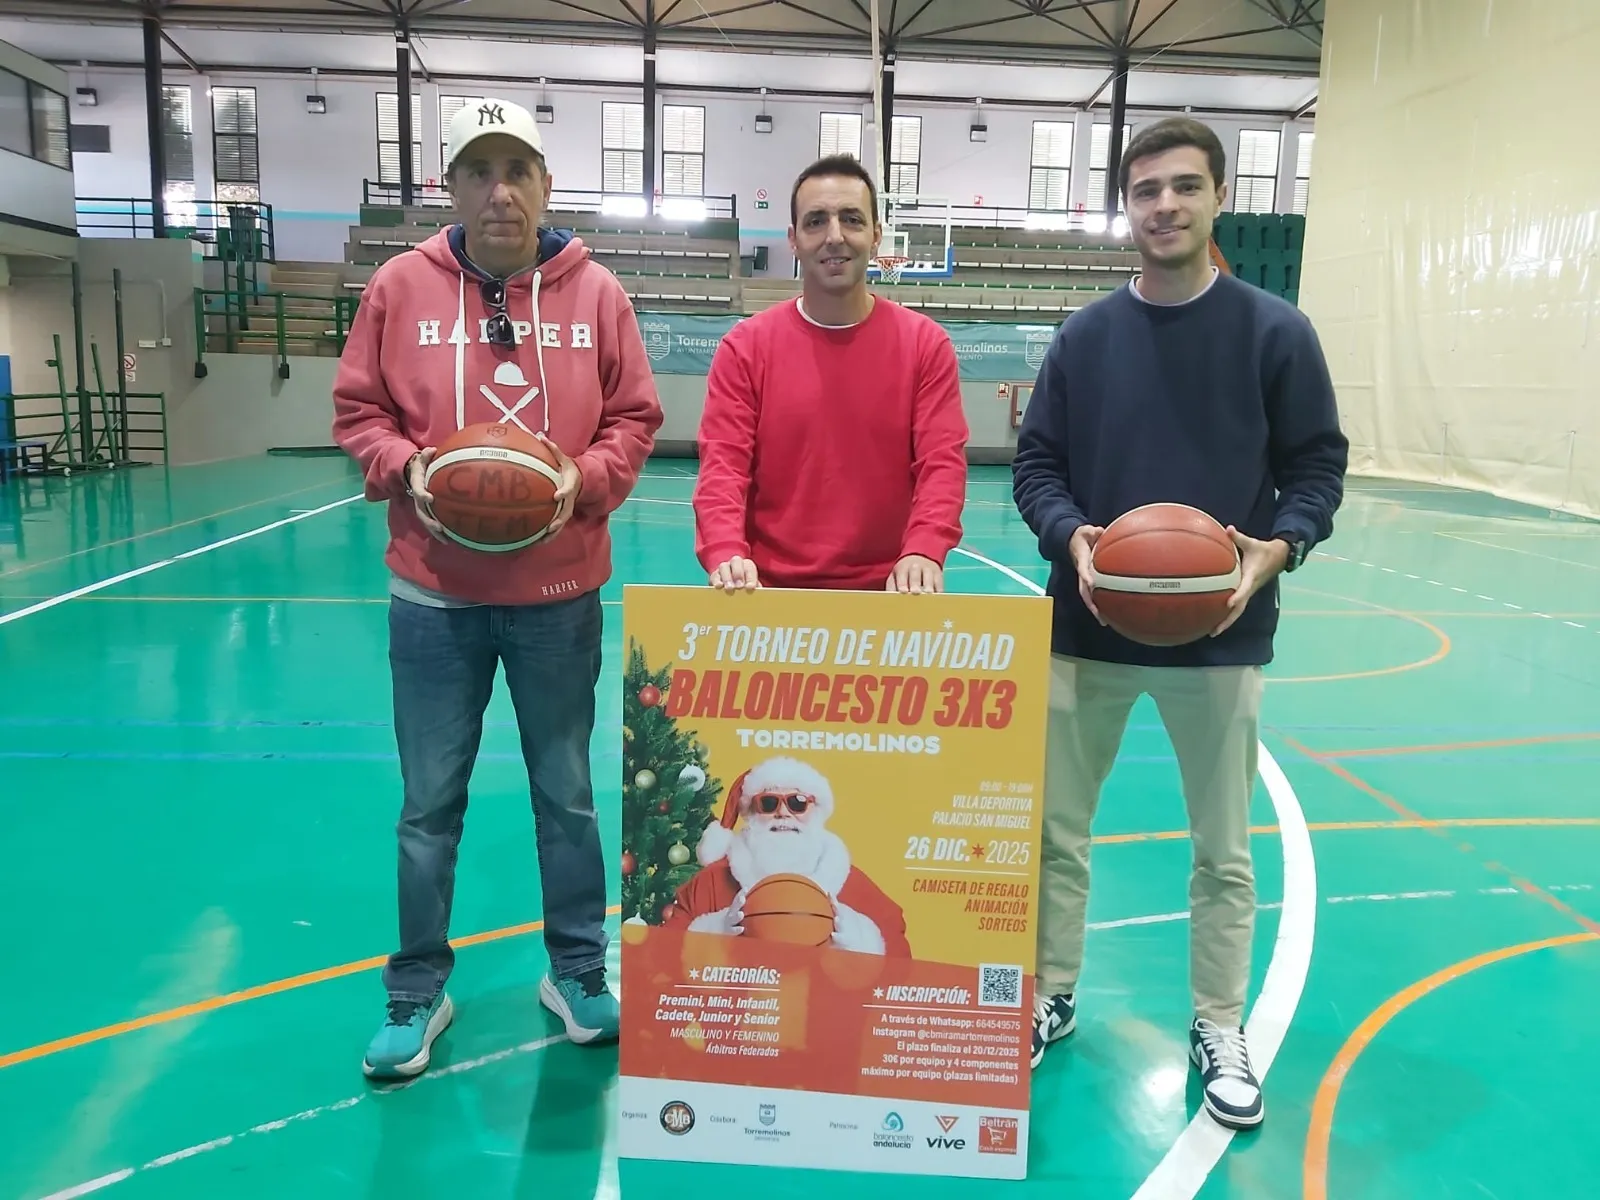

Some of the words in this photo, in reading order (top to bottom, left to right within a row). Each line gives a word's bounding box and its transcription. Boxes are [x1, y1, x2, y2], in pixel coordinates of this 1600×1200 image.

[446, 466, 531, 501] CMB
[541, 580, 579, 596] HARPER
[715, 625, 830, 665] TORNEO
[834, 629, 877, 666] DE
[880, 629, 1015, 671] NAVIDAD
[664, 669, 929, 725] BALONCESTO
[933, 677, 1017, 730] 3X3
[736, 728, 941, 755] TORREMOLINOS
[952, 794, 979, 809] VILLA
[979, 797, 1033, 812] DEPORTIVA
[932, 811, 971, 826] PALACIO
[973, 813, 994, 828] SAN
[994, 815, 1031, 829] MIGUEL
[904, 836, 931, 860] 26
[933, 837, 970, 862] DIC.
[985, 840, 1031, 865] 2025
[912, 879, 967, 895] CAMISETA
[969, 882, 986, 896] DE
[986, 883, 1029, 898] REGALO
[964, 898, 1028, 915] ANIMACIÓN
[978, 917, 1028, 932] SORTEOS
[702, 966, 781, 985] CATEGORÍAS:
[659, 994, 705, 1008] Premini,
[707, 996, 734, 1009] Mini,
[736, 997, 780, 1011] Infantil,
[886, 985, 971, 1005] INSCRIPCIÓN:
[655, 1009, 696, 1022] Cadete,
[698, 1011, 733, 1023] Junior
[733, 1015, 741, 1026] y
[743, 1012, 780, 1025] Senior
[881, 1014, 887, 1023] A
[889, 1014, 915, 1024] través
[917, 1015, 927, 1025] de
[929, 1016, 974, 1029] Whatsapp:
[670, 1027, 722, 1040] MASCULINO
[725, 1030, 731, 1040] Y
[732, 1031, 780, 1043] FEMENINO
[873, 1026, 916, 1038] Instagram
[706, 1041, 737, 1055] Árbitros
[739, 1044, 779, 1057] Federados
[897, 1041, 905, 1051] El
[907, 1041, 929, 1052] plazo
[931, 1043, 961, 1054] finaliza
[963, 1045, 971, 1054] el
[973, 1045, 1020, 1057] 20/12/2025
[900, 1056, 914, 1066] por
[916, 1057, 946, 1067] equipo
[961, 1060, 1019, 1070] componentes
[861, 1066, 894, 1077] máximo
[896, 1069, 910, 1078] por
[912, 1069, 941, 1080] equipo
[943, 1070, 973, 1082] (plazas
[975, 1071, 1018, 1085] limitadas)
[744, 1127, 791, 1137] Torremolinos
[926, 1135, 966, 1150] vive
